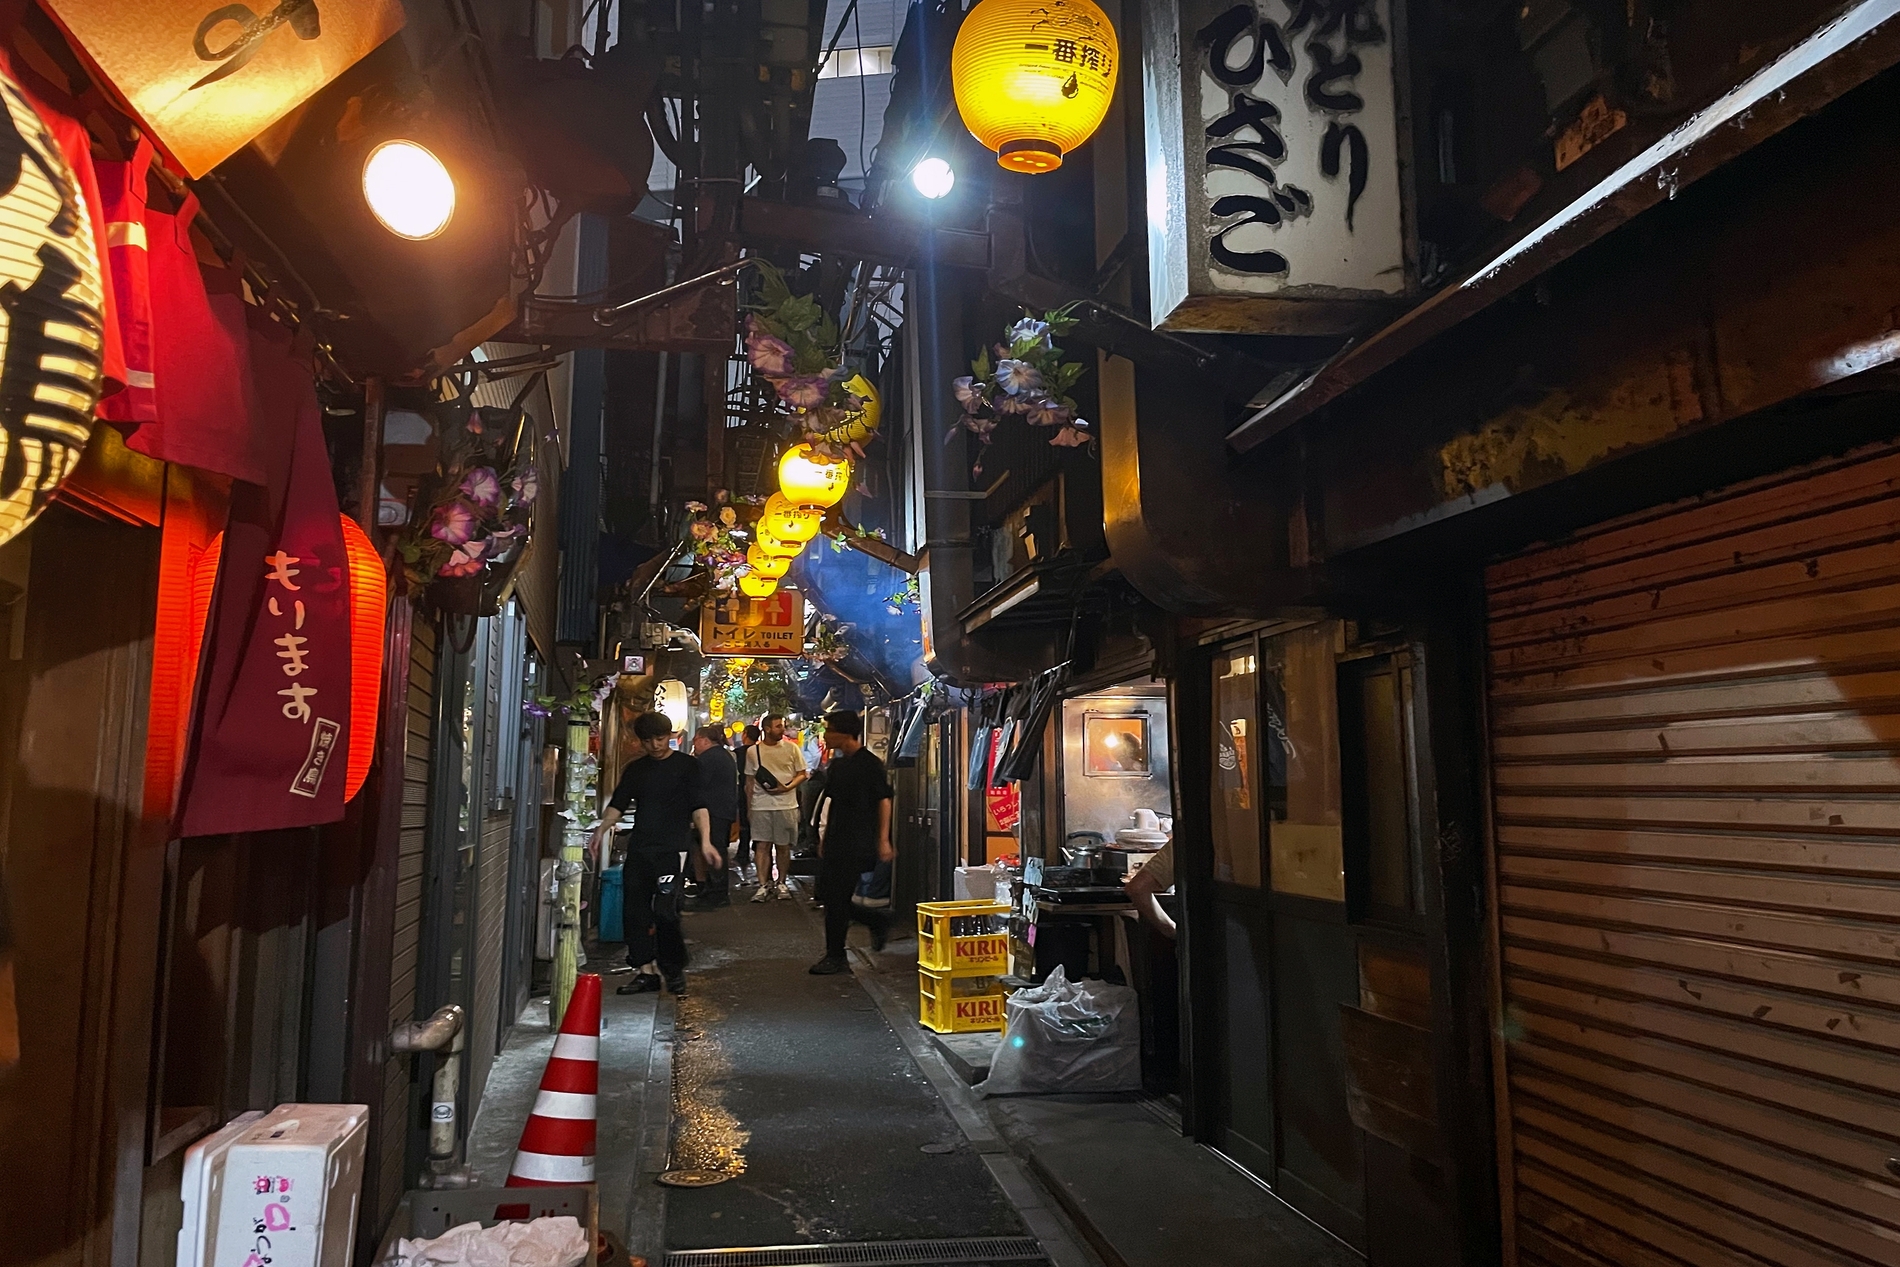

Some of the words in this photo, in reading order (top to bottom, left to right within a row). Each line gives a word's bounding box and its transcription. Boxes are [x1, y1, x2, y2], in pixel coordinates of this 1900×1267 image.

[1024, 38, 1113, 78] 一番搾り
[713, 626, 756, 640] トイレ
[761, 631, 793, 640] TOILET
